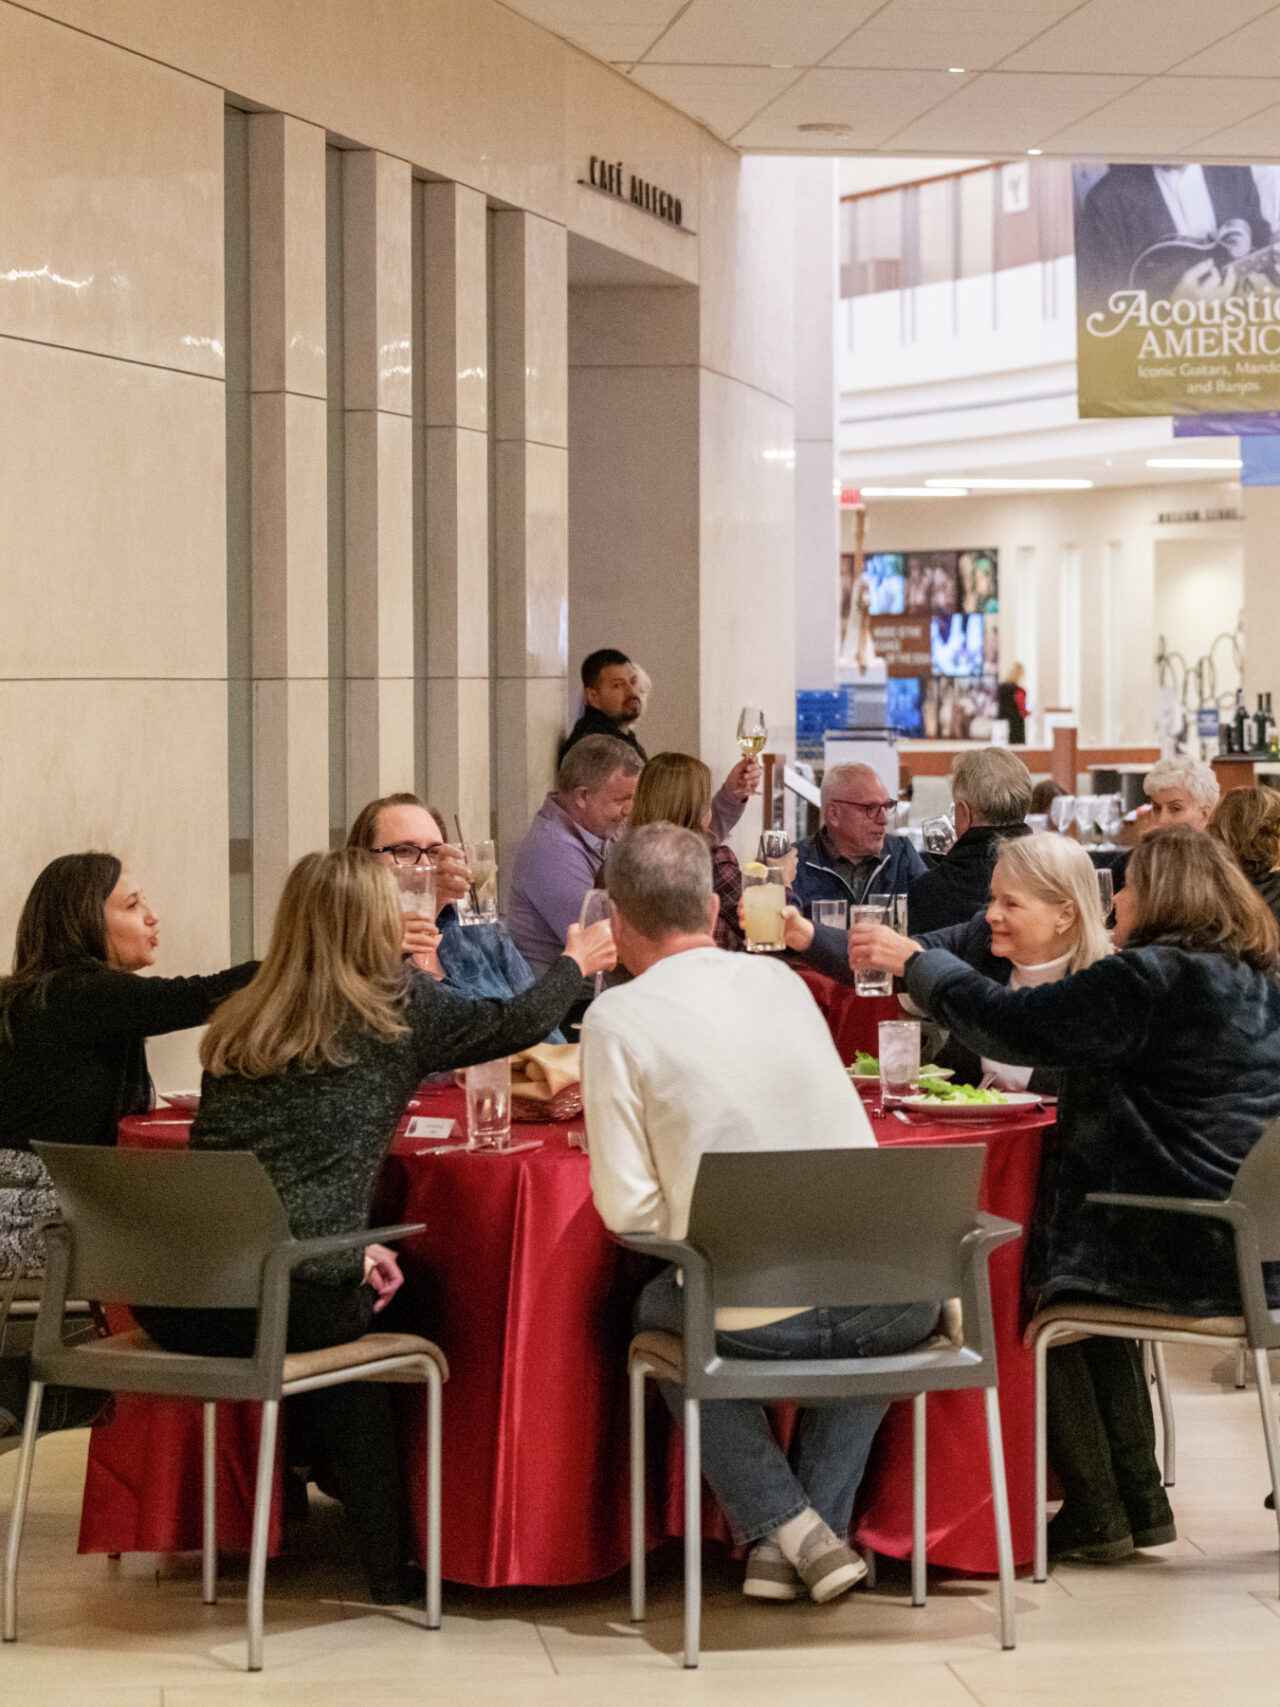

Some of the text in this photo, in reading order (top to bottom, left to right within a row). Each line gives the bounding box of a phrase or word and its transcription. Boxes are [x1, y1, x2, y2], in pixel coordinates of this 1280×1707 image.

[1138, 364, 1176, 378] Iconic
[1179, 362, 1232, 377] Guitars,
[1187, 379, 1260, 395] and Banjos
